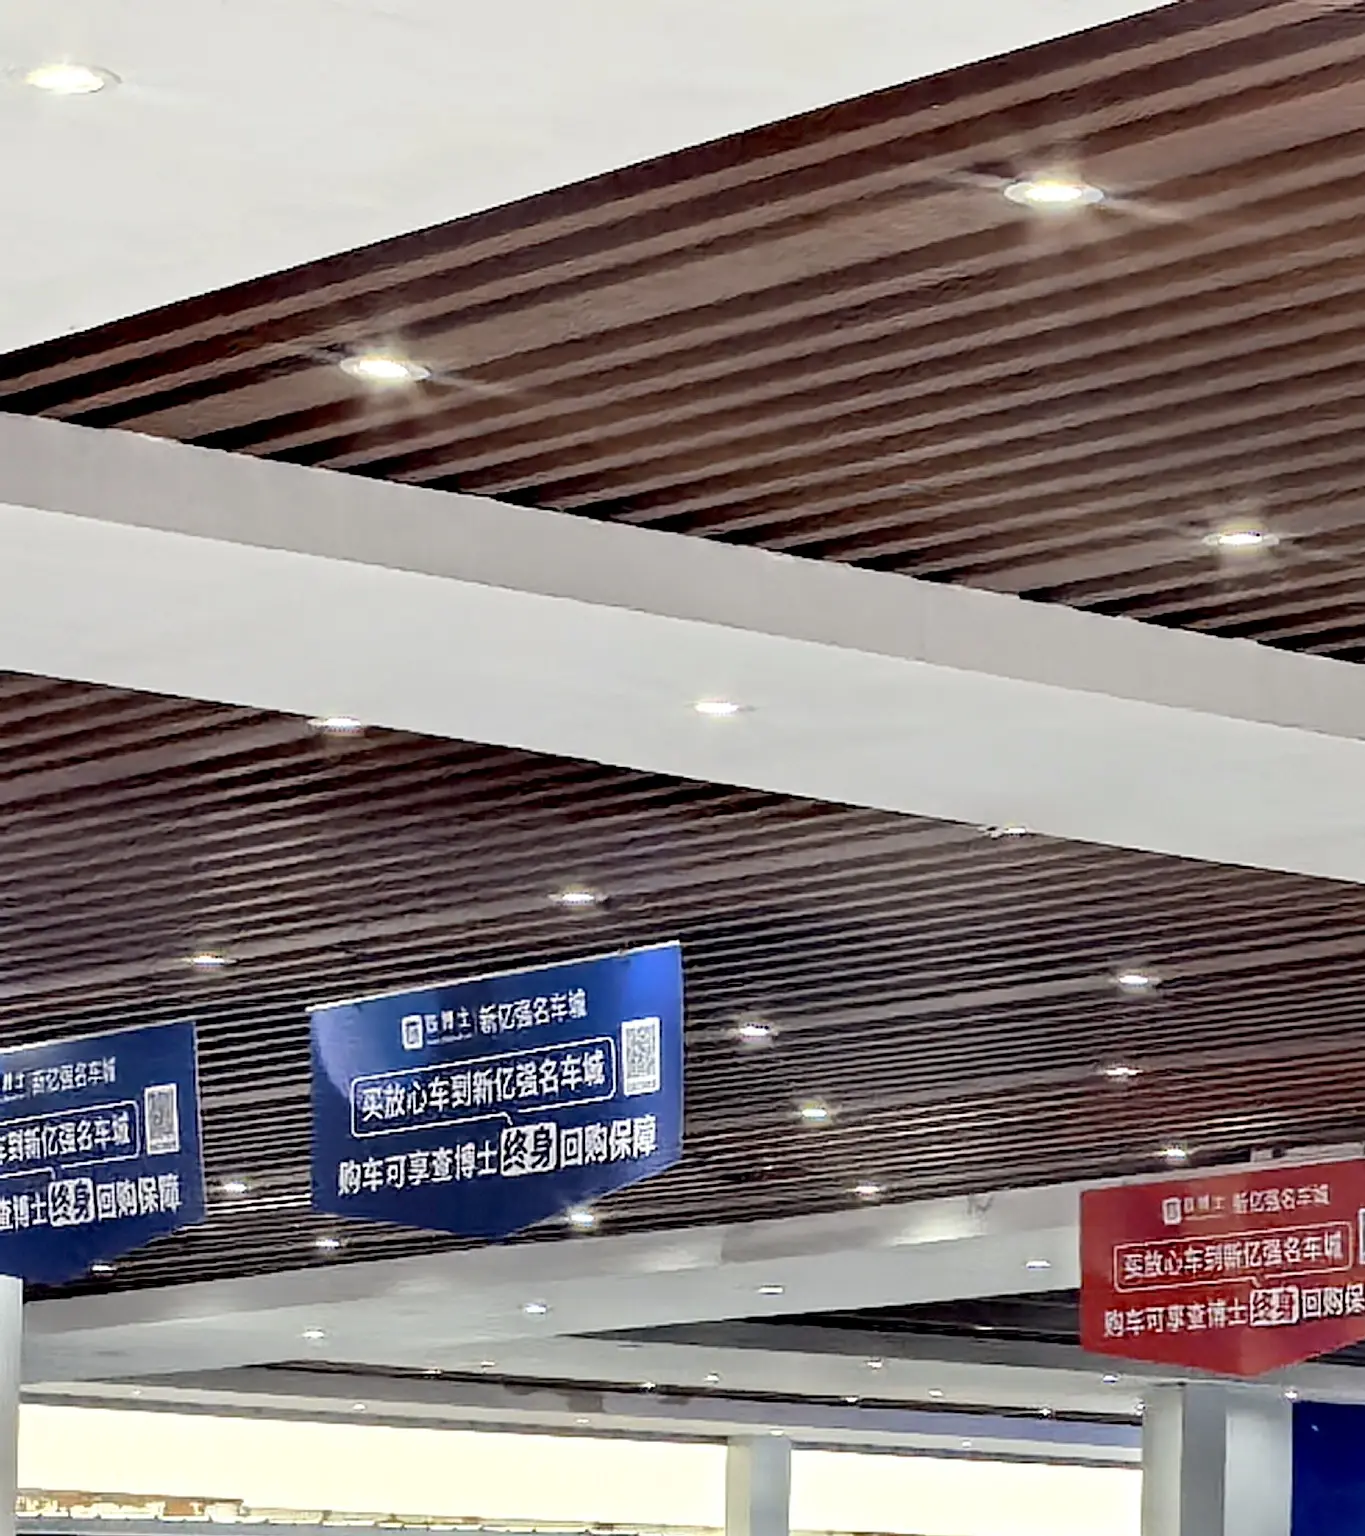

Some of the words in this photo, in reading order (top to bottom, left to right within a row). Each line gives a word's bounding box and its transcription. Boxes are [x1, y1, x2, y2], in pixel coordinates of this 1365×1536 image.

[479, 988, 588, 1035] 新亿强名车城
[360, 1049, 606, 1122] 买放心车到新亿强名车城
[337, 1115, 658, 1197] 购车可享查博士终身回购保障
[1123, 1230, 1343, 1280] 买放心车到新亿强名车城
